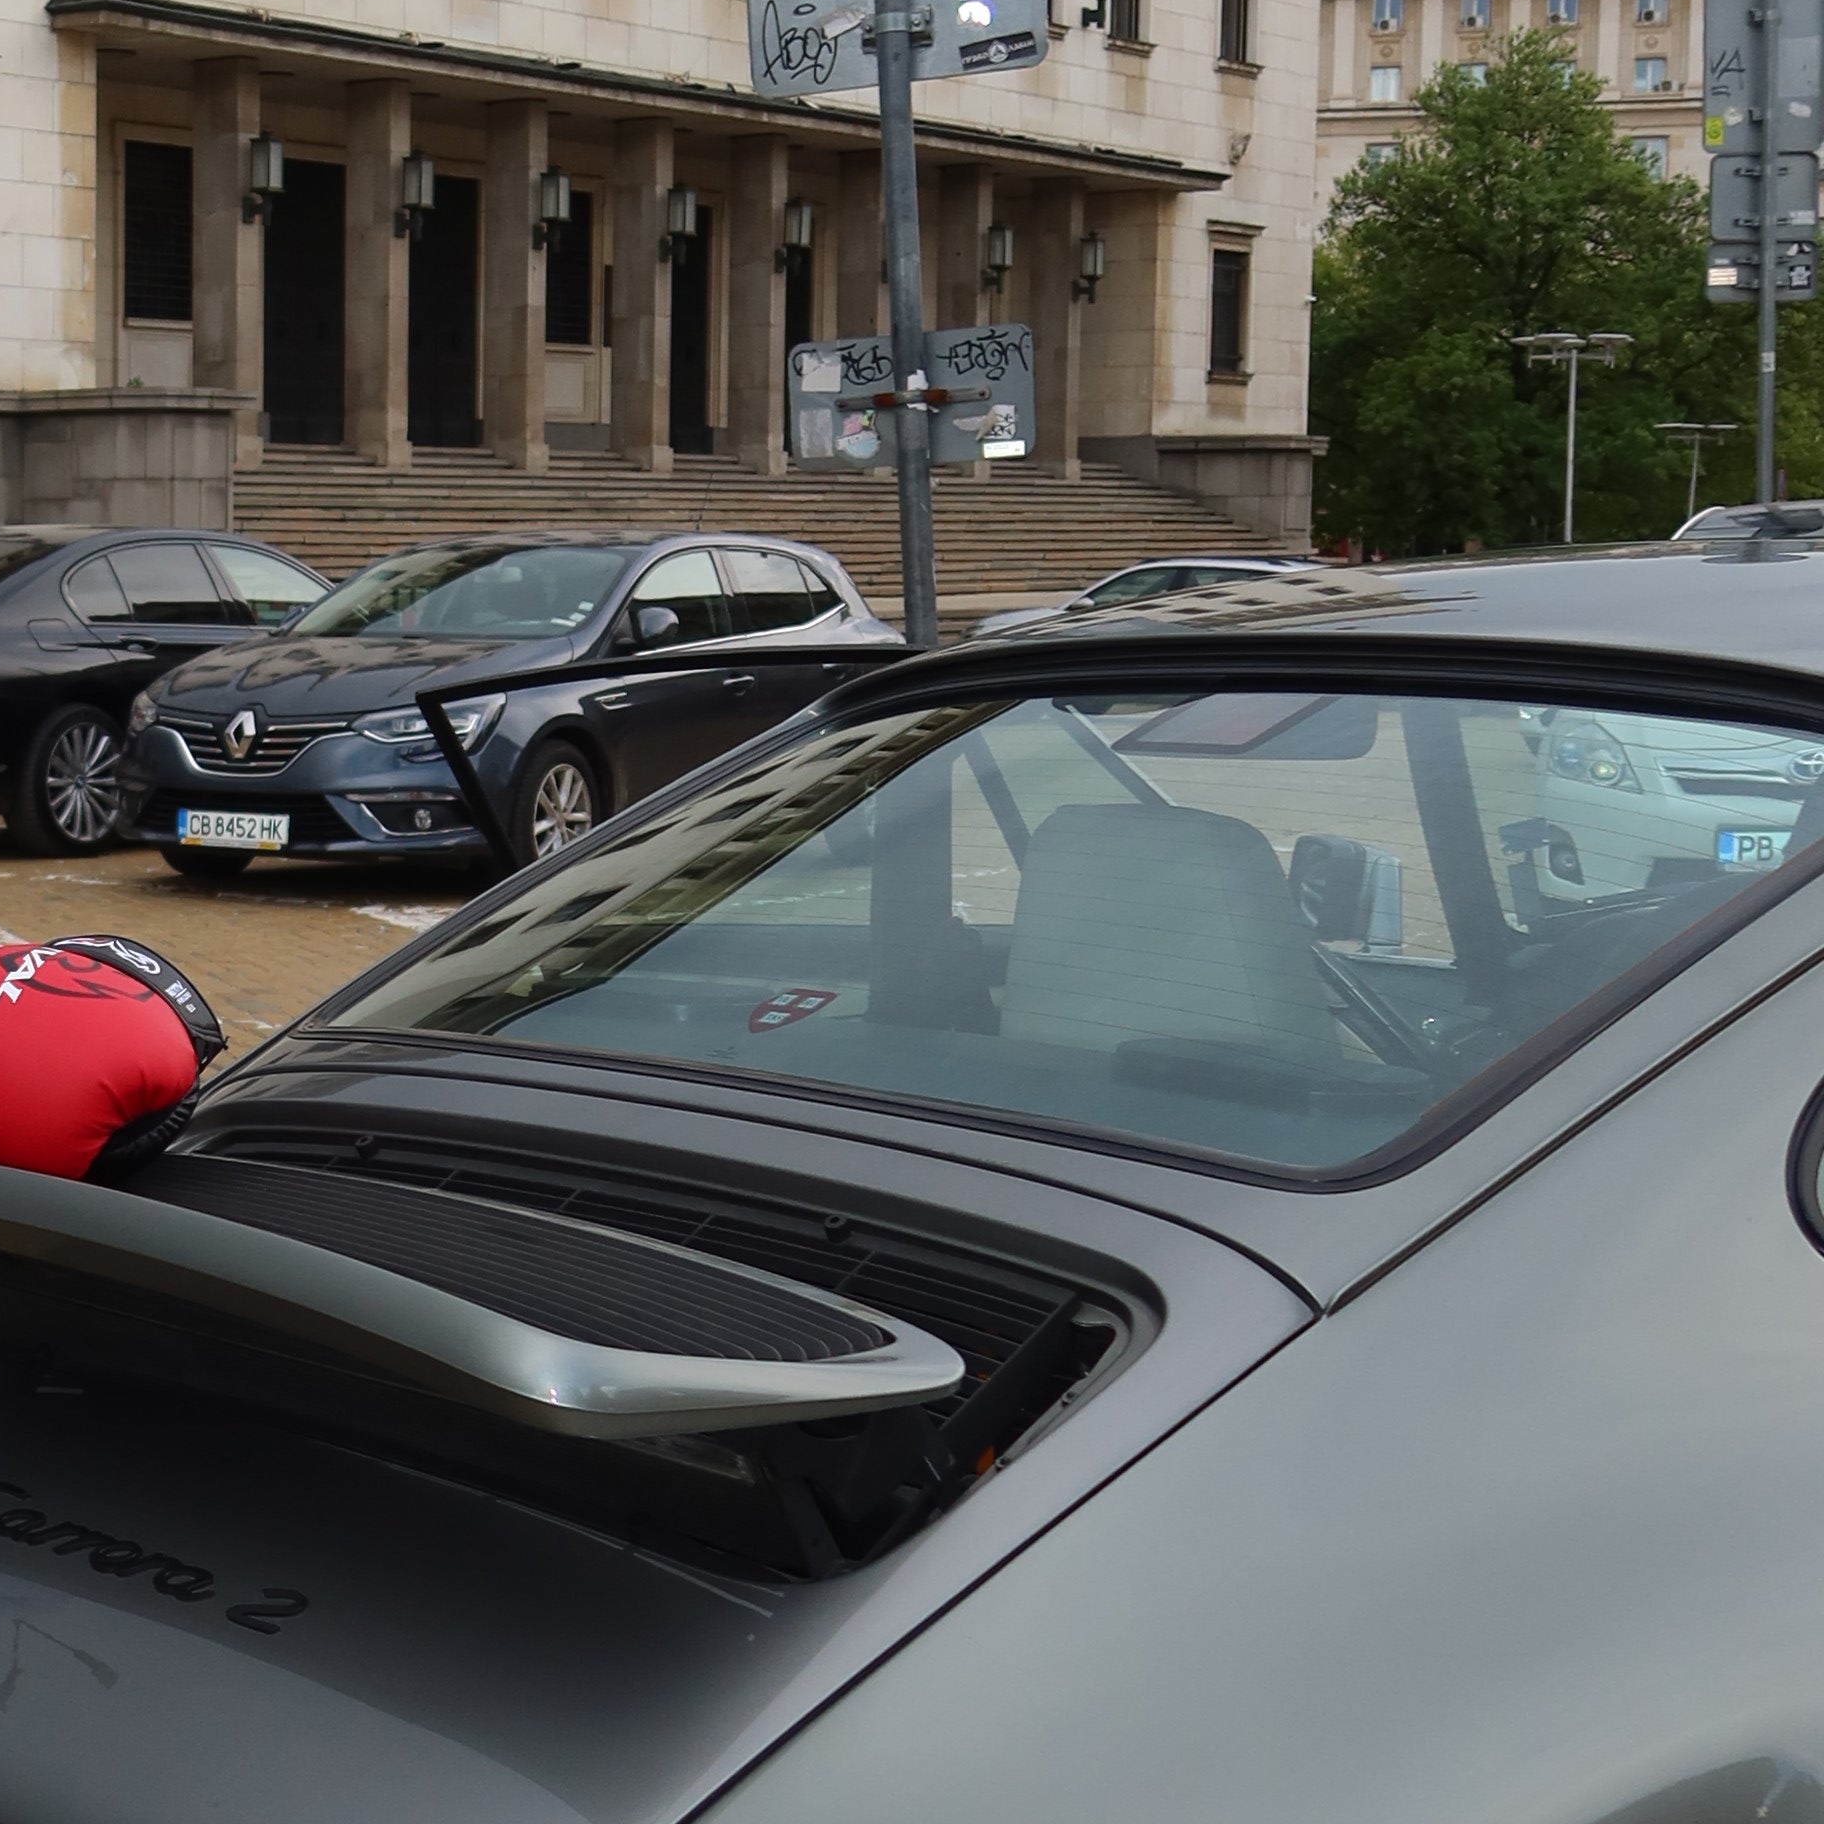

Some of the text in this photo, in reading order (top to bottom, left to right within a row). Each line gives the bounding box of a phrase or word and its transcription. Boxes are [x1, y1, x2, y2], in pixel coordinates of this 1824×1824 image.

[189, 814, 283, 841] CB 8452 HK
[1738, 836, 1774, 861] PB
[226, 1587, 308, 1635] 2
